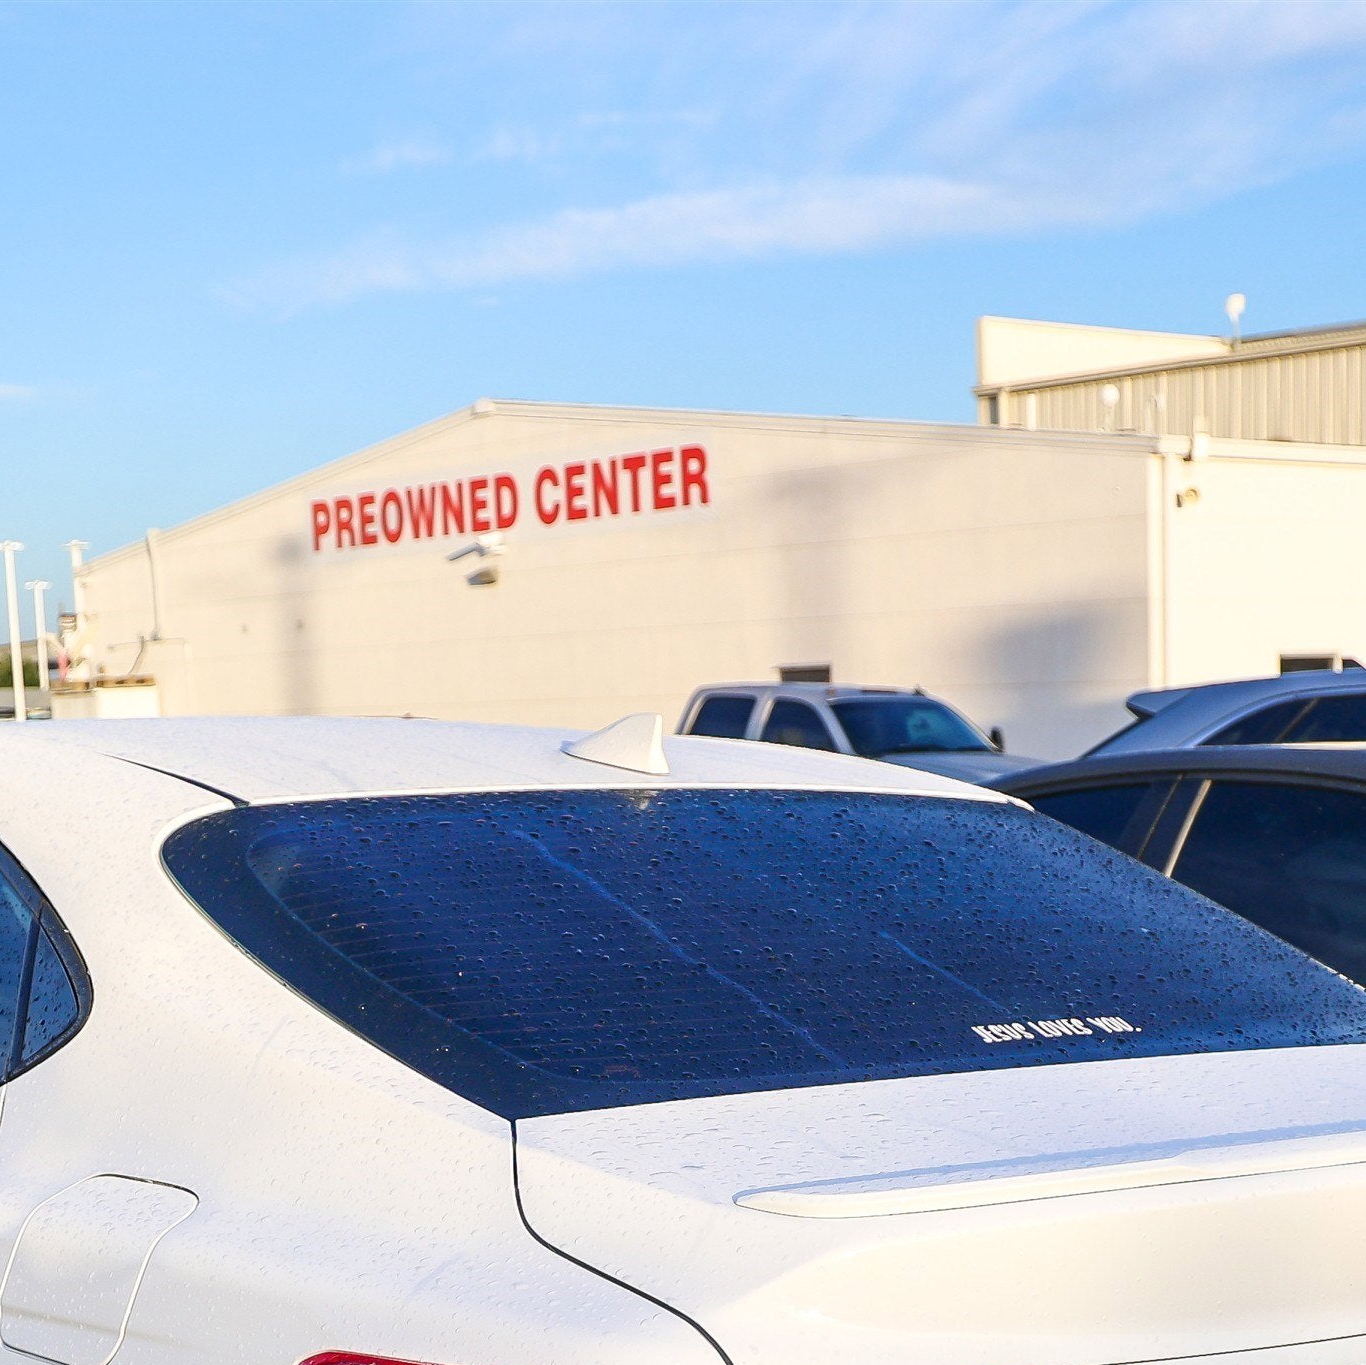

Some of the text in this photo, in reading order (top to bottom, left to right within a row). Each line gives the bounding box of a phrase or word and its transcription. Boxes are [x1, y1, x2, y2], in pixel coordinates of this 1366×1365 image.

[310, 445, 710, 551] PREOWNED CENTER
[971, 1022, 1035, 1043] JESUS
[1028, 1018, 1093, 1038] LOVES
